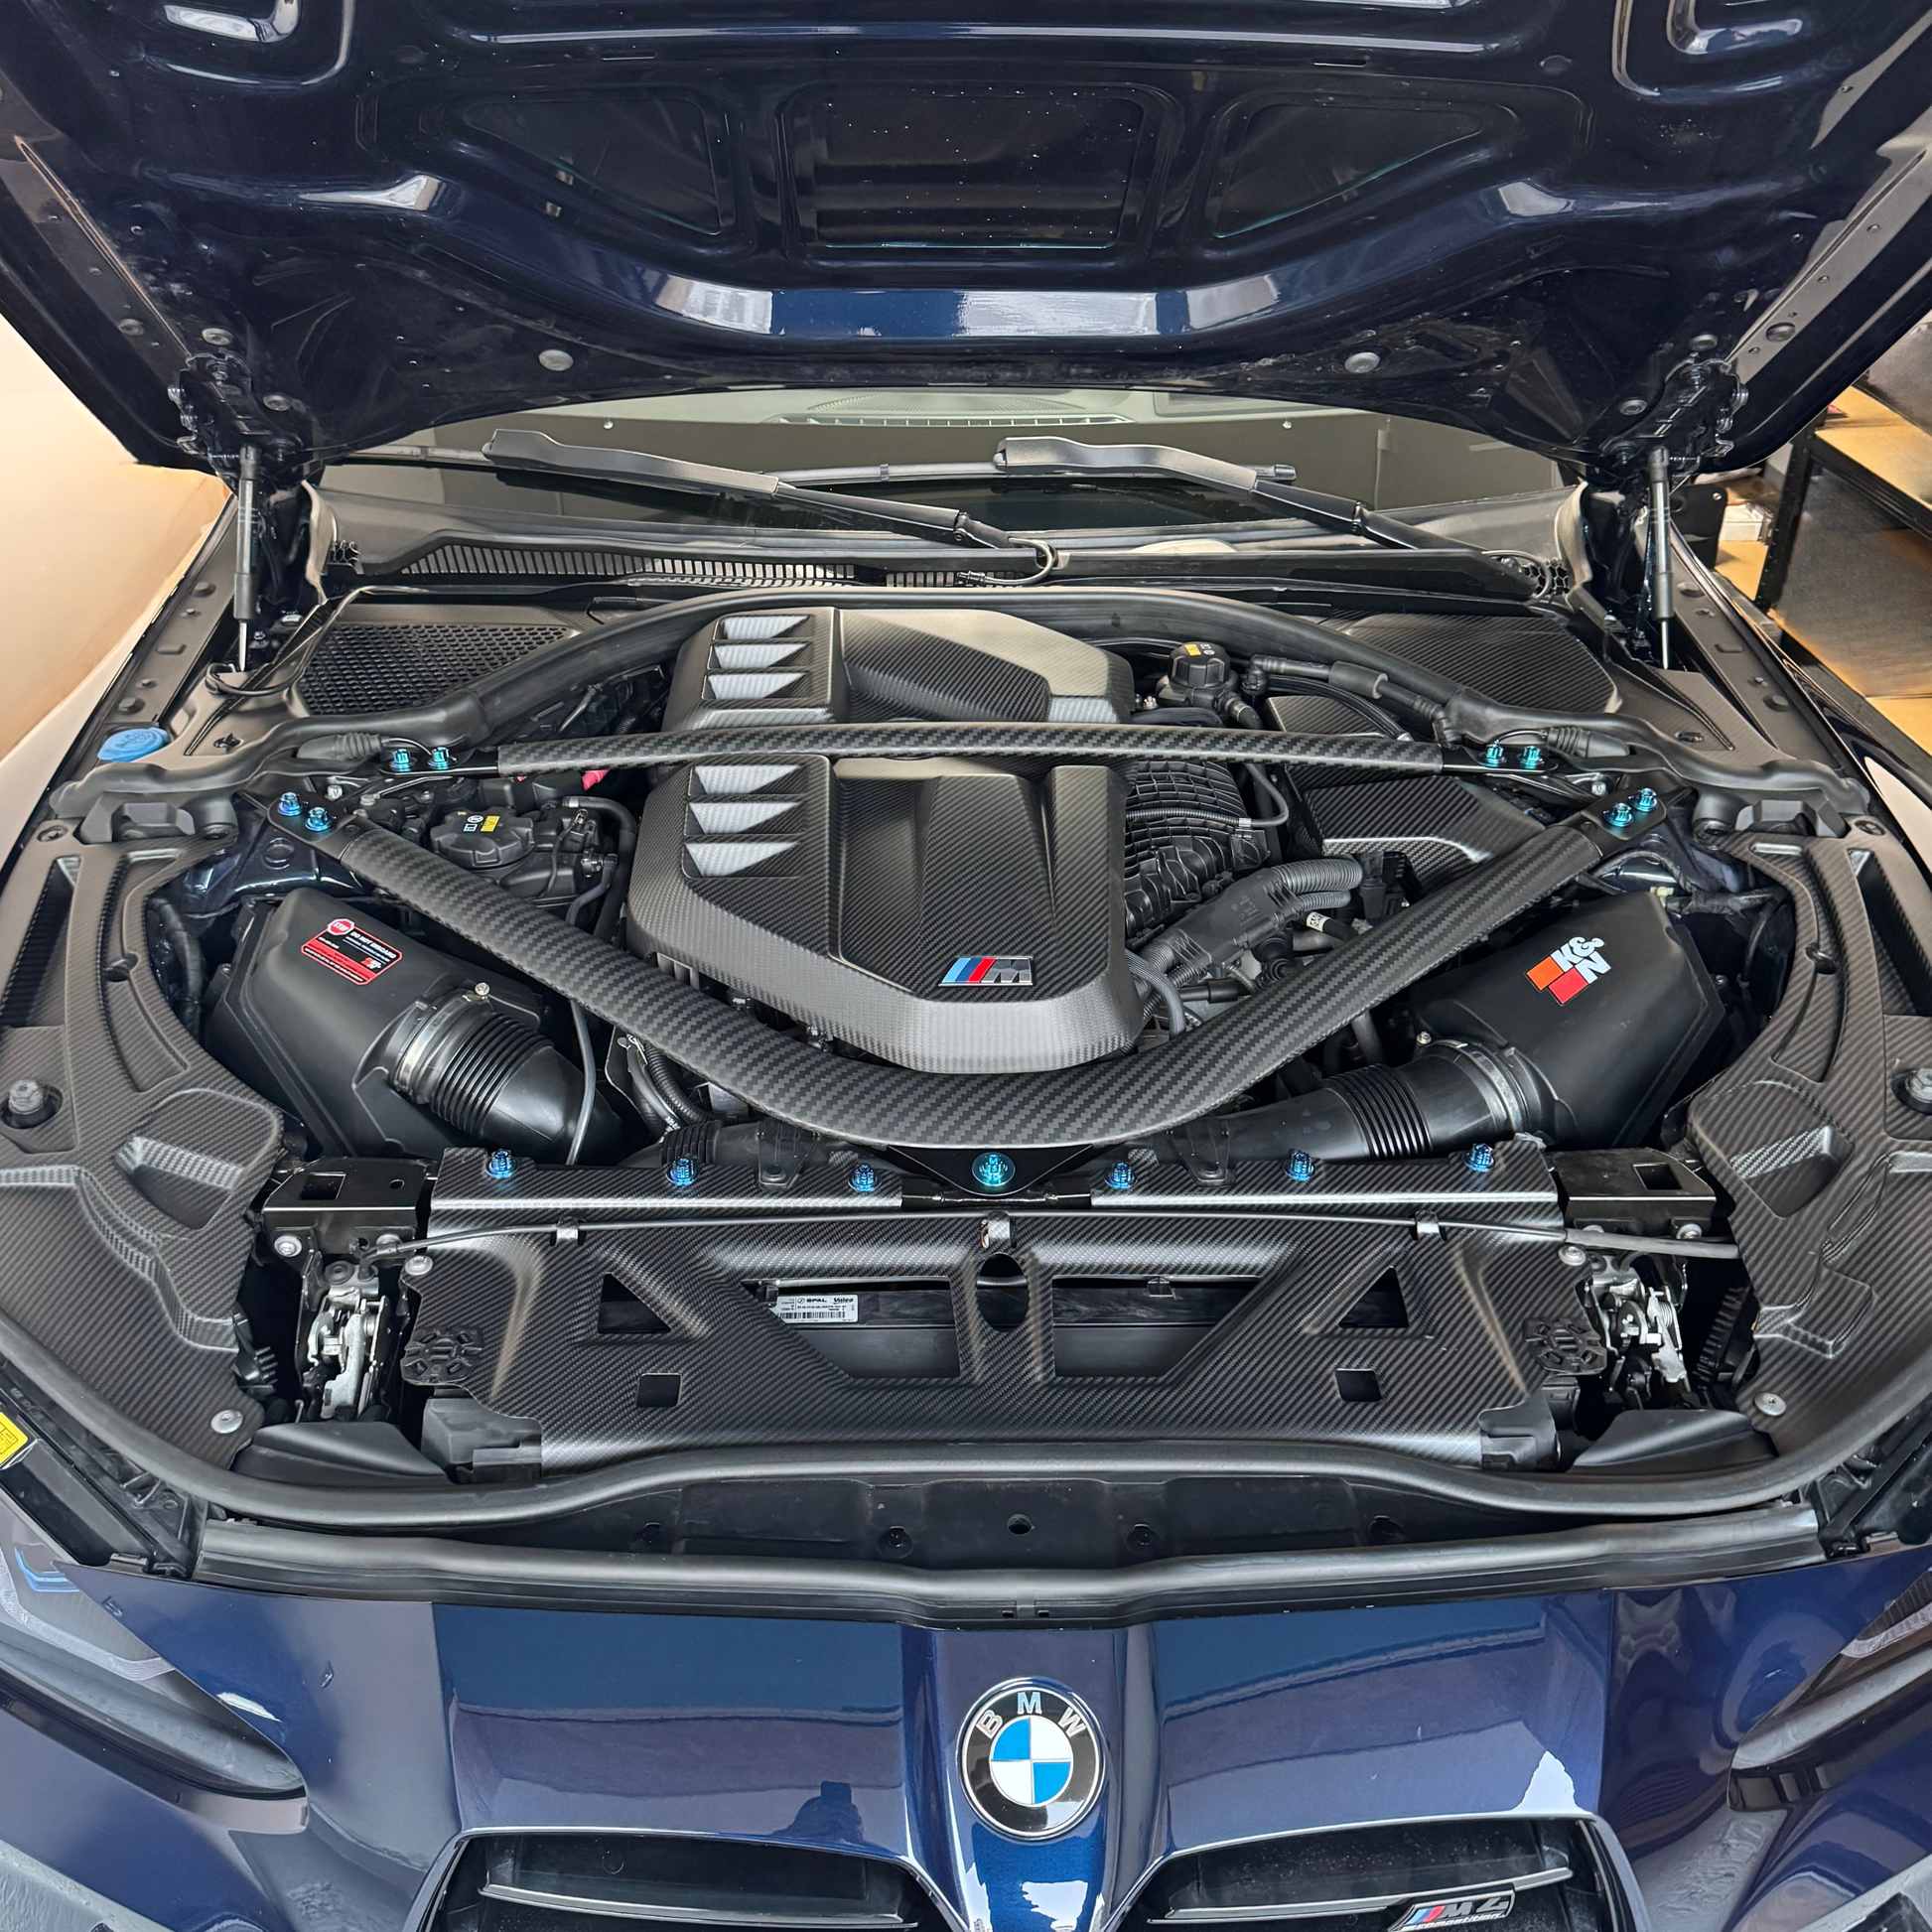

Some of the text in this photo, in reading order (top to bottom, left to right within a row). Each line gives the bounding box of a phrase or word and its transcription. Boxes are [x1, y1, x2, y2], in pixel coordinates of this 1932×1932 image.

[333, 921, 350, 931] STOP
[359, 935, 373, 945] NOT
[371, 941, 397, 959] DISCARD
[979, 958, 1032, 983] M
[1550, 936, 1611, 984] K&N
[976, 1691, 1087, 1739] BMW
